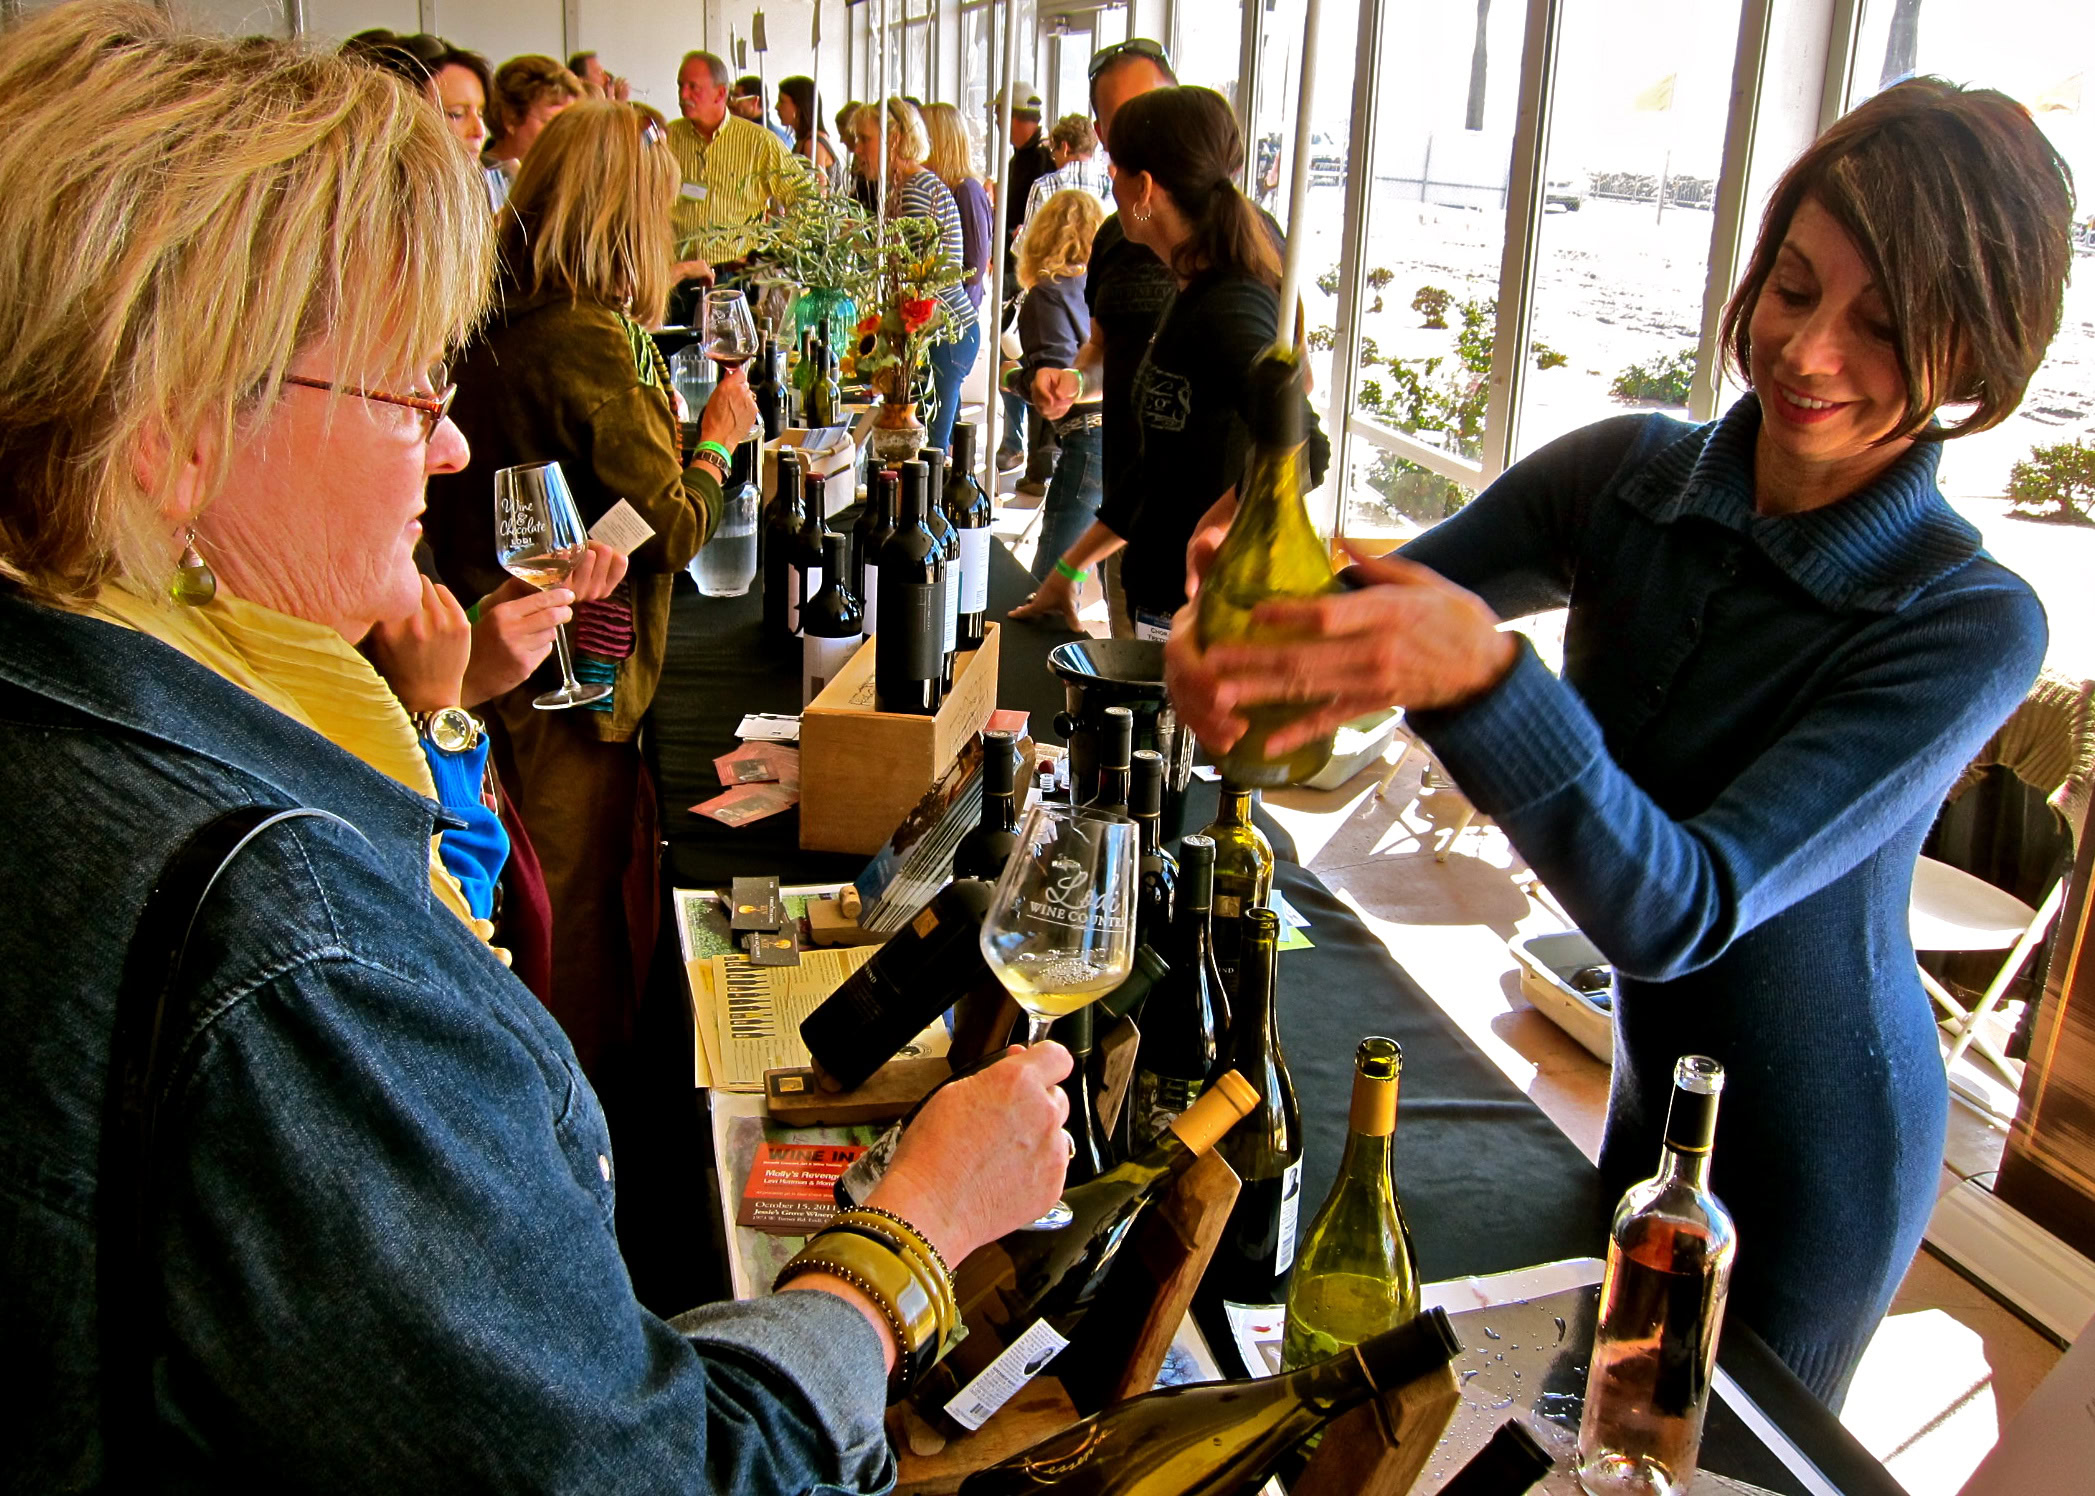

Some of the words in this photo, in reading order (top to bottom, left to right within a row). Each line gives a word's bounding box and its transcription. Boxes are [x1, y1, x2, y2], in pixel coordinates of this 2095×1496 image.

[501, 498, 533, 514] Wine
[500, 516, 546, 536] Chocolate
[516, 512, 528, 526] &
[511, 537, 532, 545] LODI
[1045, 871, 1120, 912] Lodi
[1029, 900, 1066, 919] WINE
[769, 1148, 824, 1161] WINE
[832, 1151, 855, 1163] IN
[765, 1169, 799, 1179] Molly's
[753, 1208, 780, 1216] Jessie's
[806, 1211, 836, 1219] Winery
[755, 1201, 794, 1209] October
[813, 1204, 836, 1212] 2011
